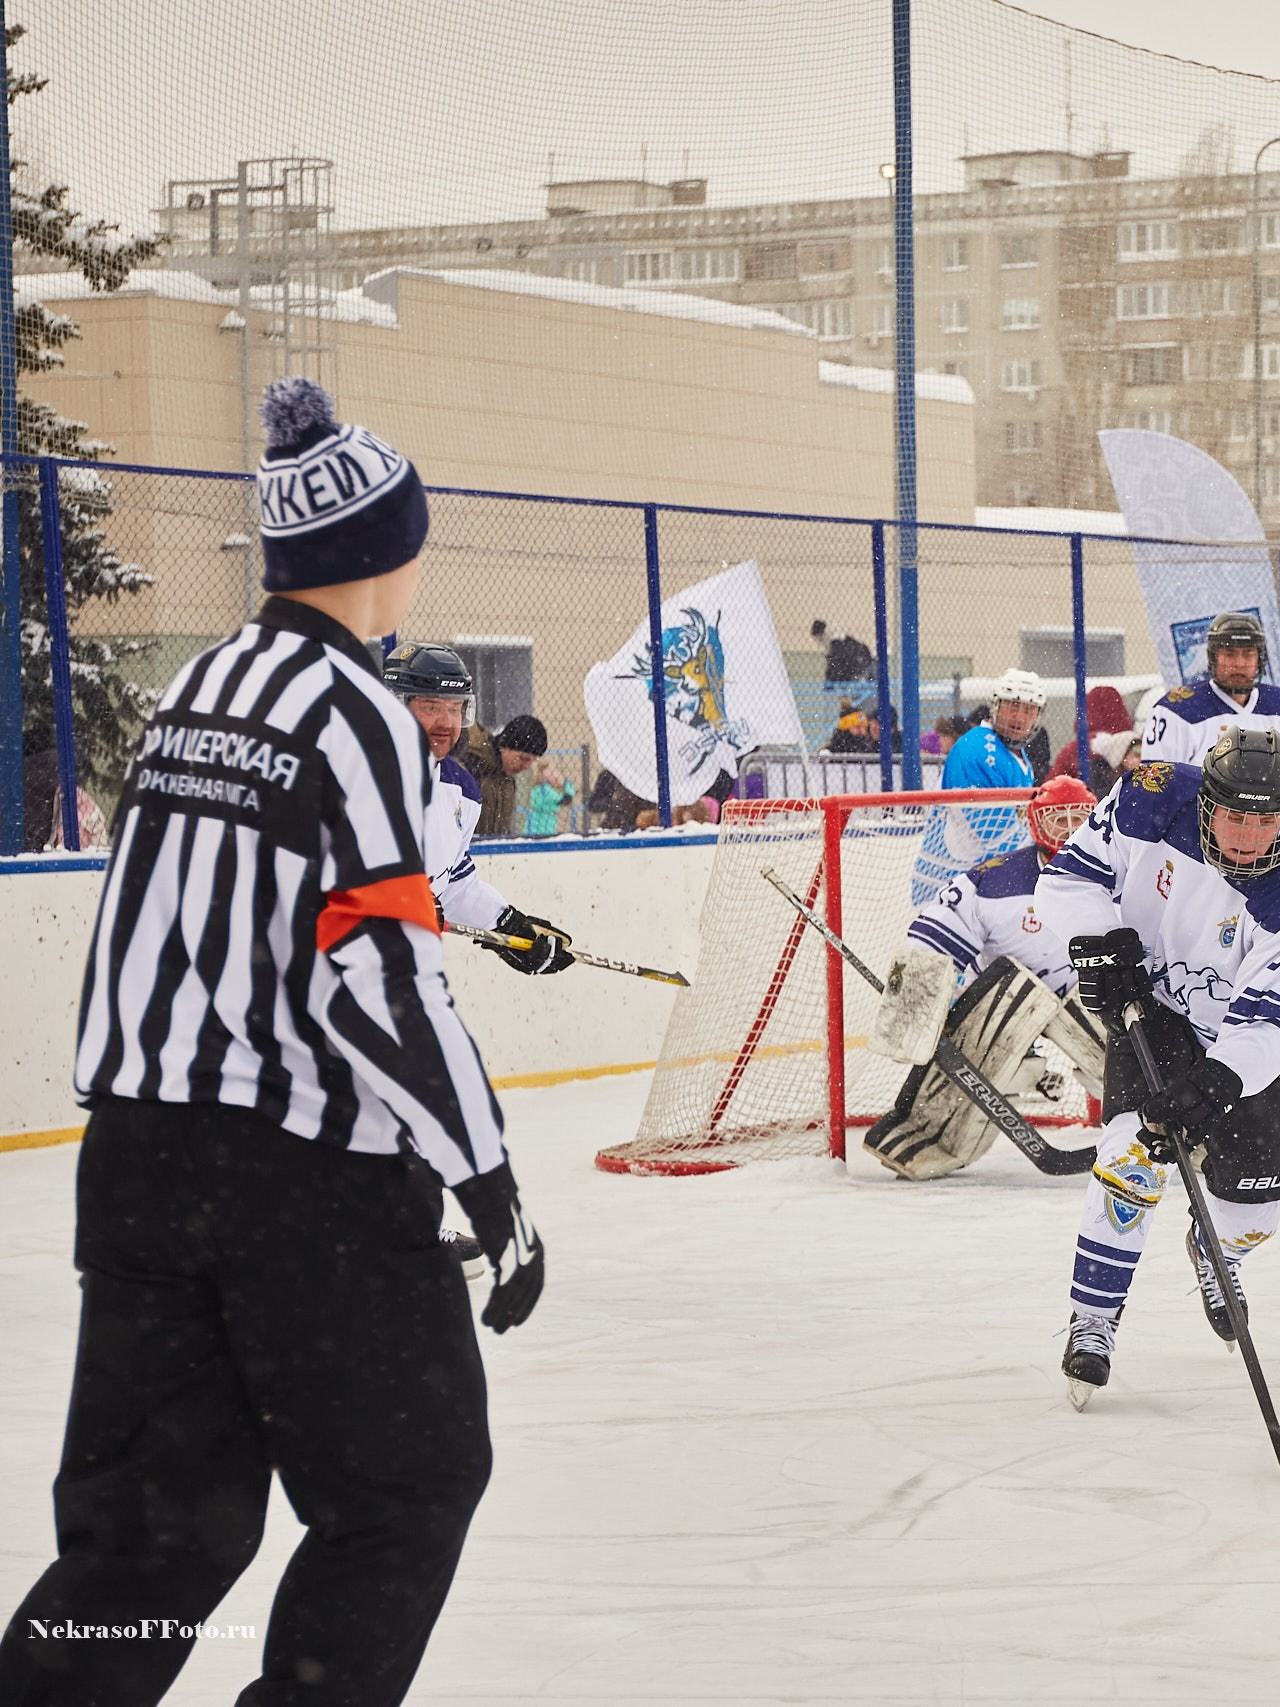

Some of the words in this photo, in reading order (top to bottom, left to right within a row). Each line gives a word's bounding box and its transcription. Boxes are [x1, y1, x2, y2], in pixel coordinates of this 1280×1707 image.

[440, 680, 465, 688] CCM
[1238, 792, 1271, 802] BAUER
[1073, 953, 1117, 968] STEX
